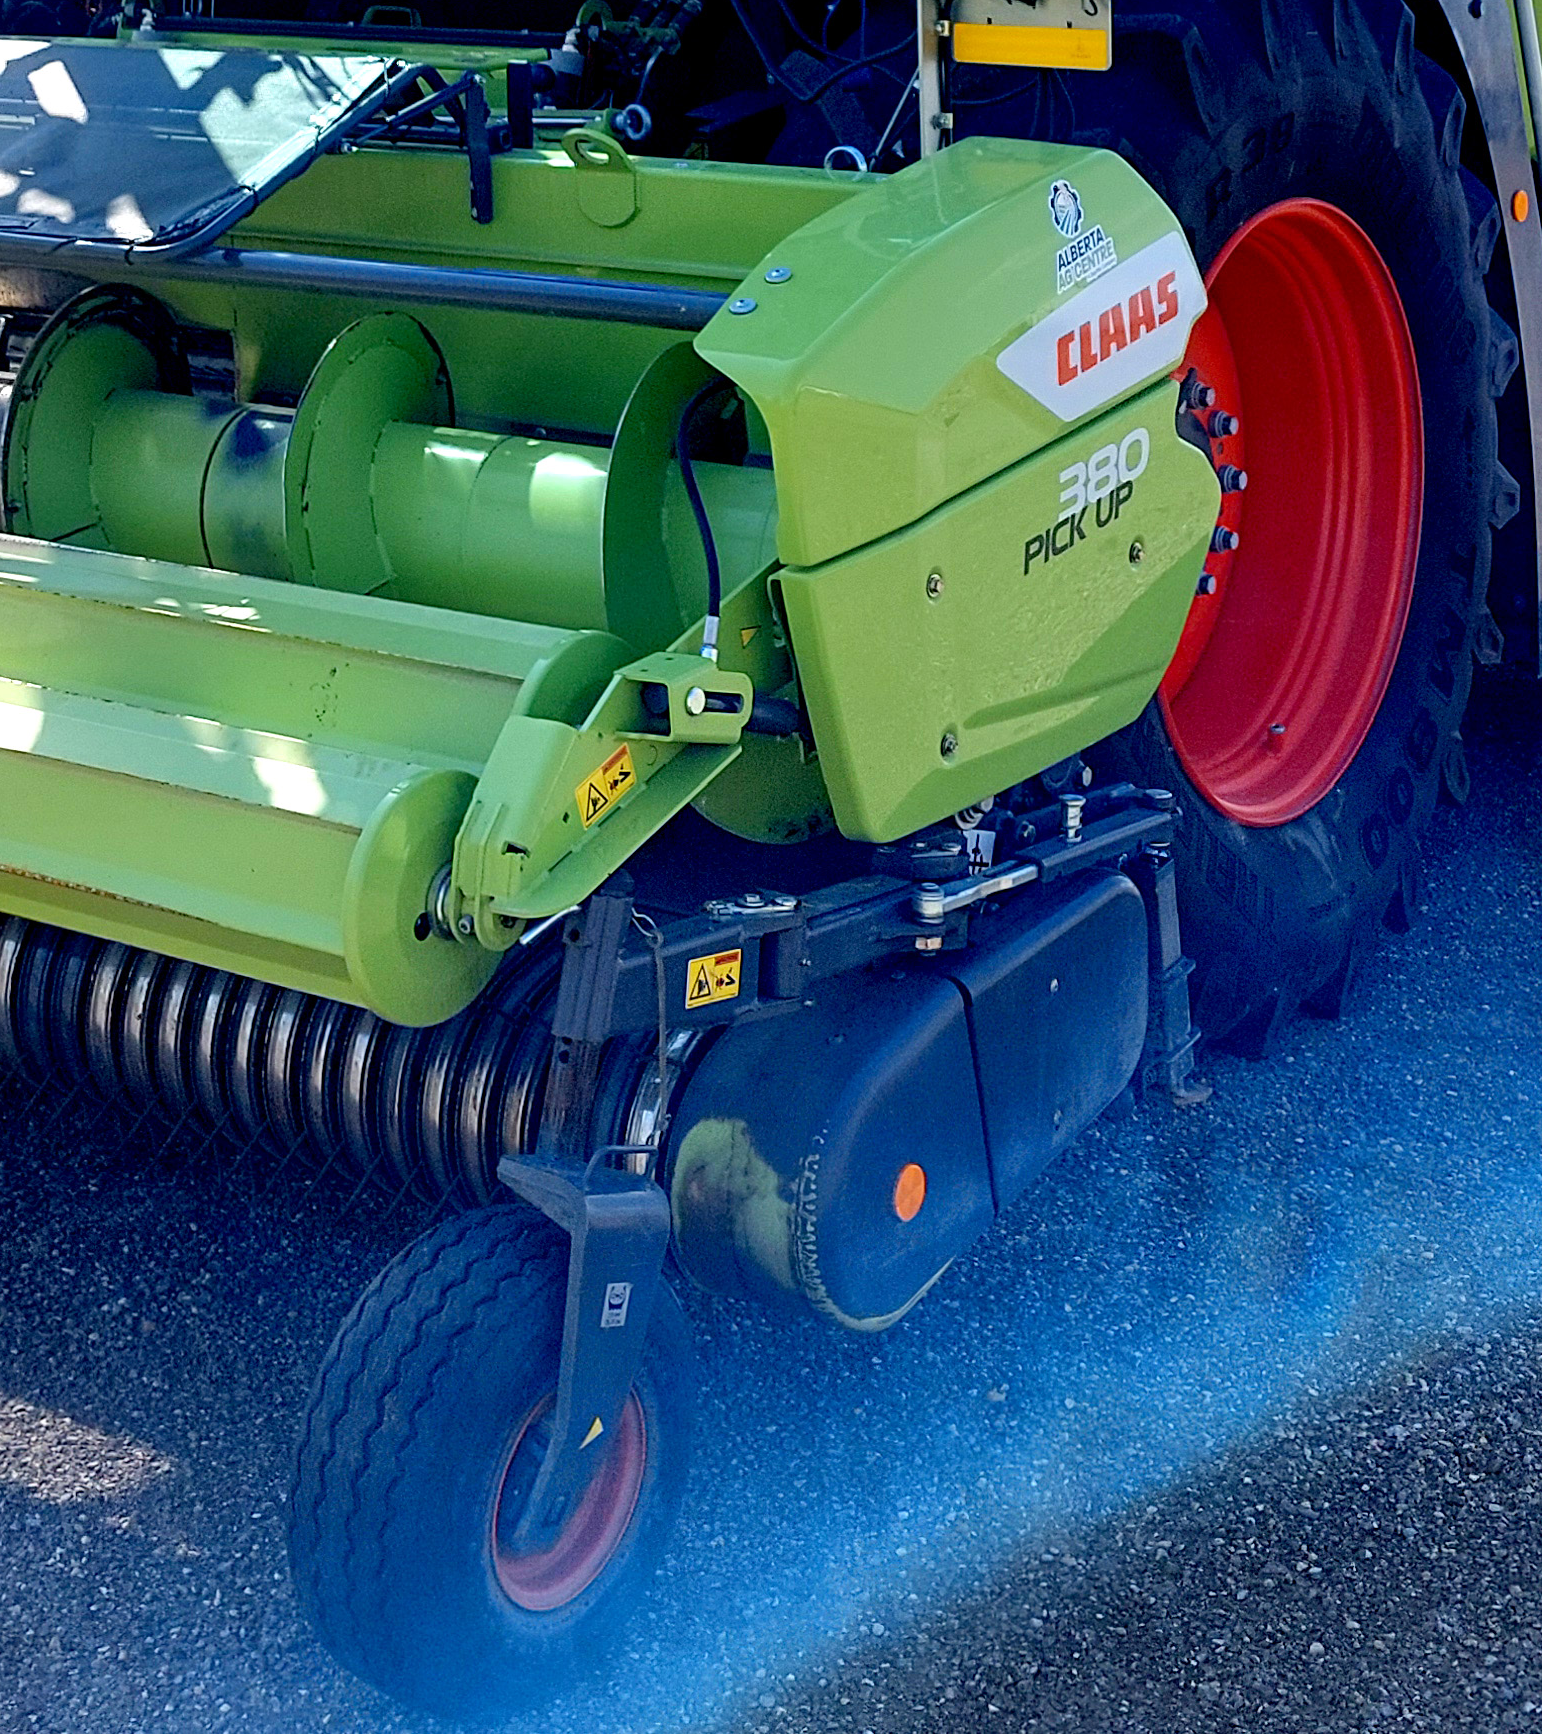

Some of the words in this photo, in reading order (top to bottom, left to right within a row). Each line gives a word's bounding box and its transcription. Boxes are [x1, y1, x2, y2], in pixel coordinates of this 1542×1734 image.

[1058, 227, 1105, 272] ALBERTA
[1059, 267, 1073, 290] AG
[1074, 240, 1114, 279] CENTRE
[1057, 270, 1179, 387] CLAAS
[1058, 427, 1151, 522] 380
[1023, 504, 1088, 577] PICK
[1095, 479, 1134, 529] UP
